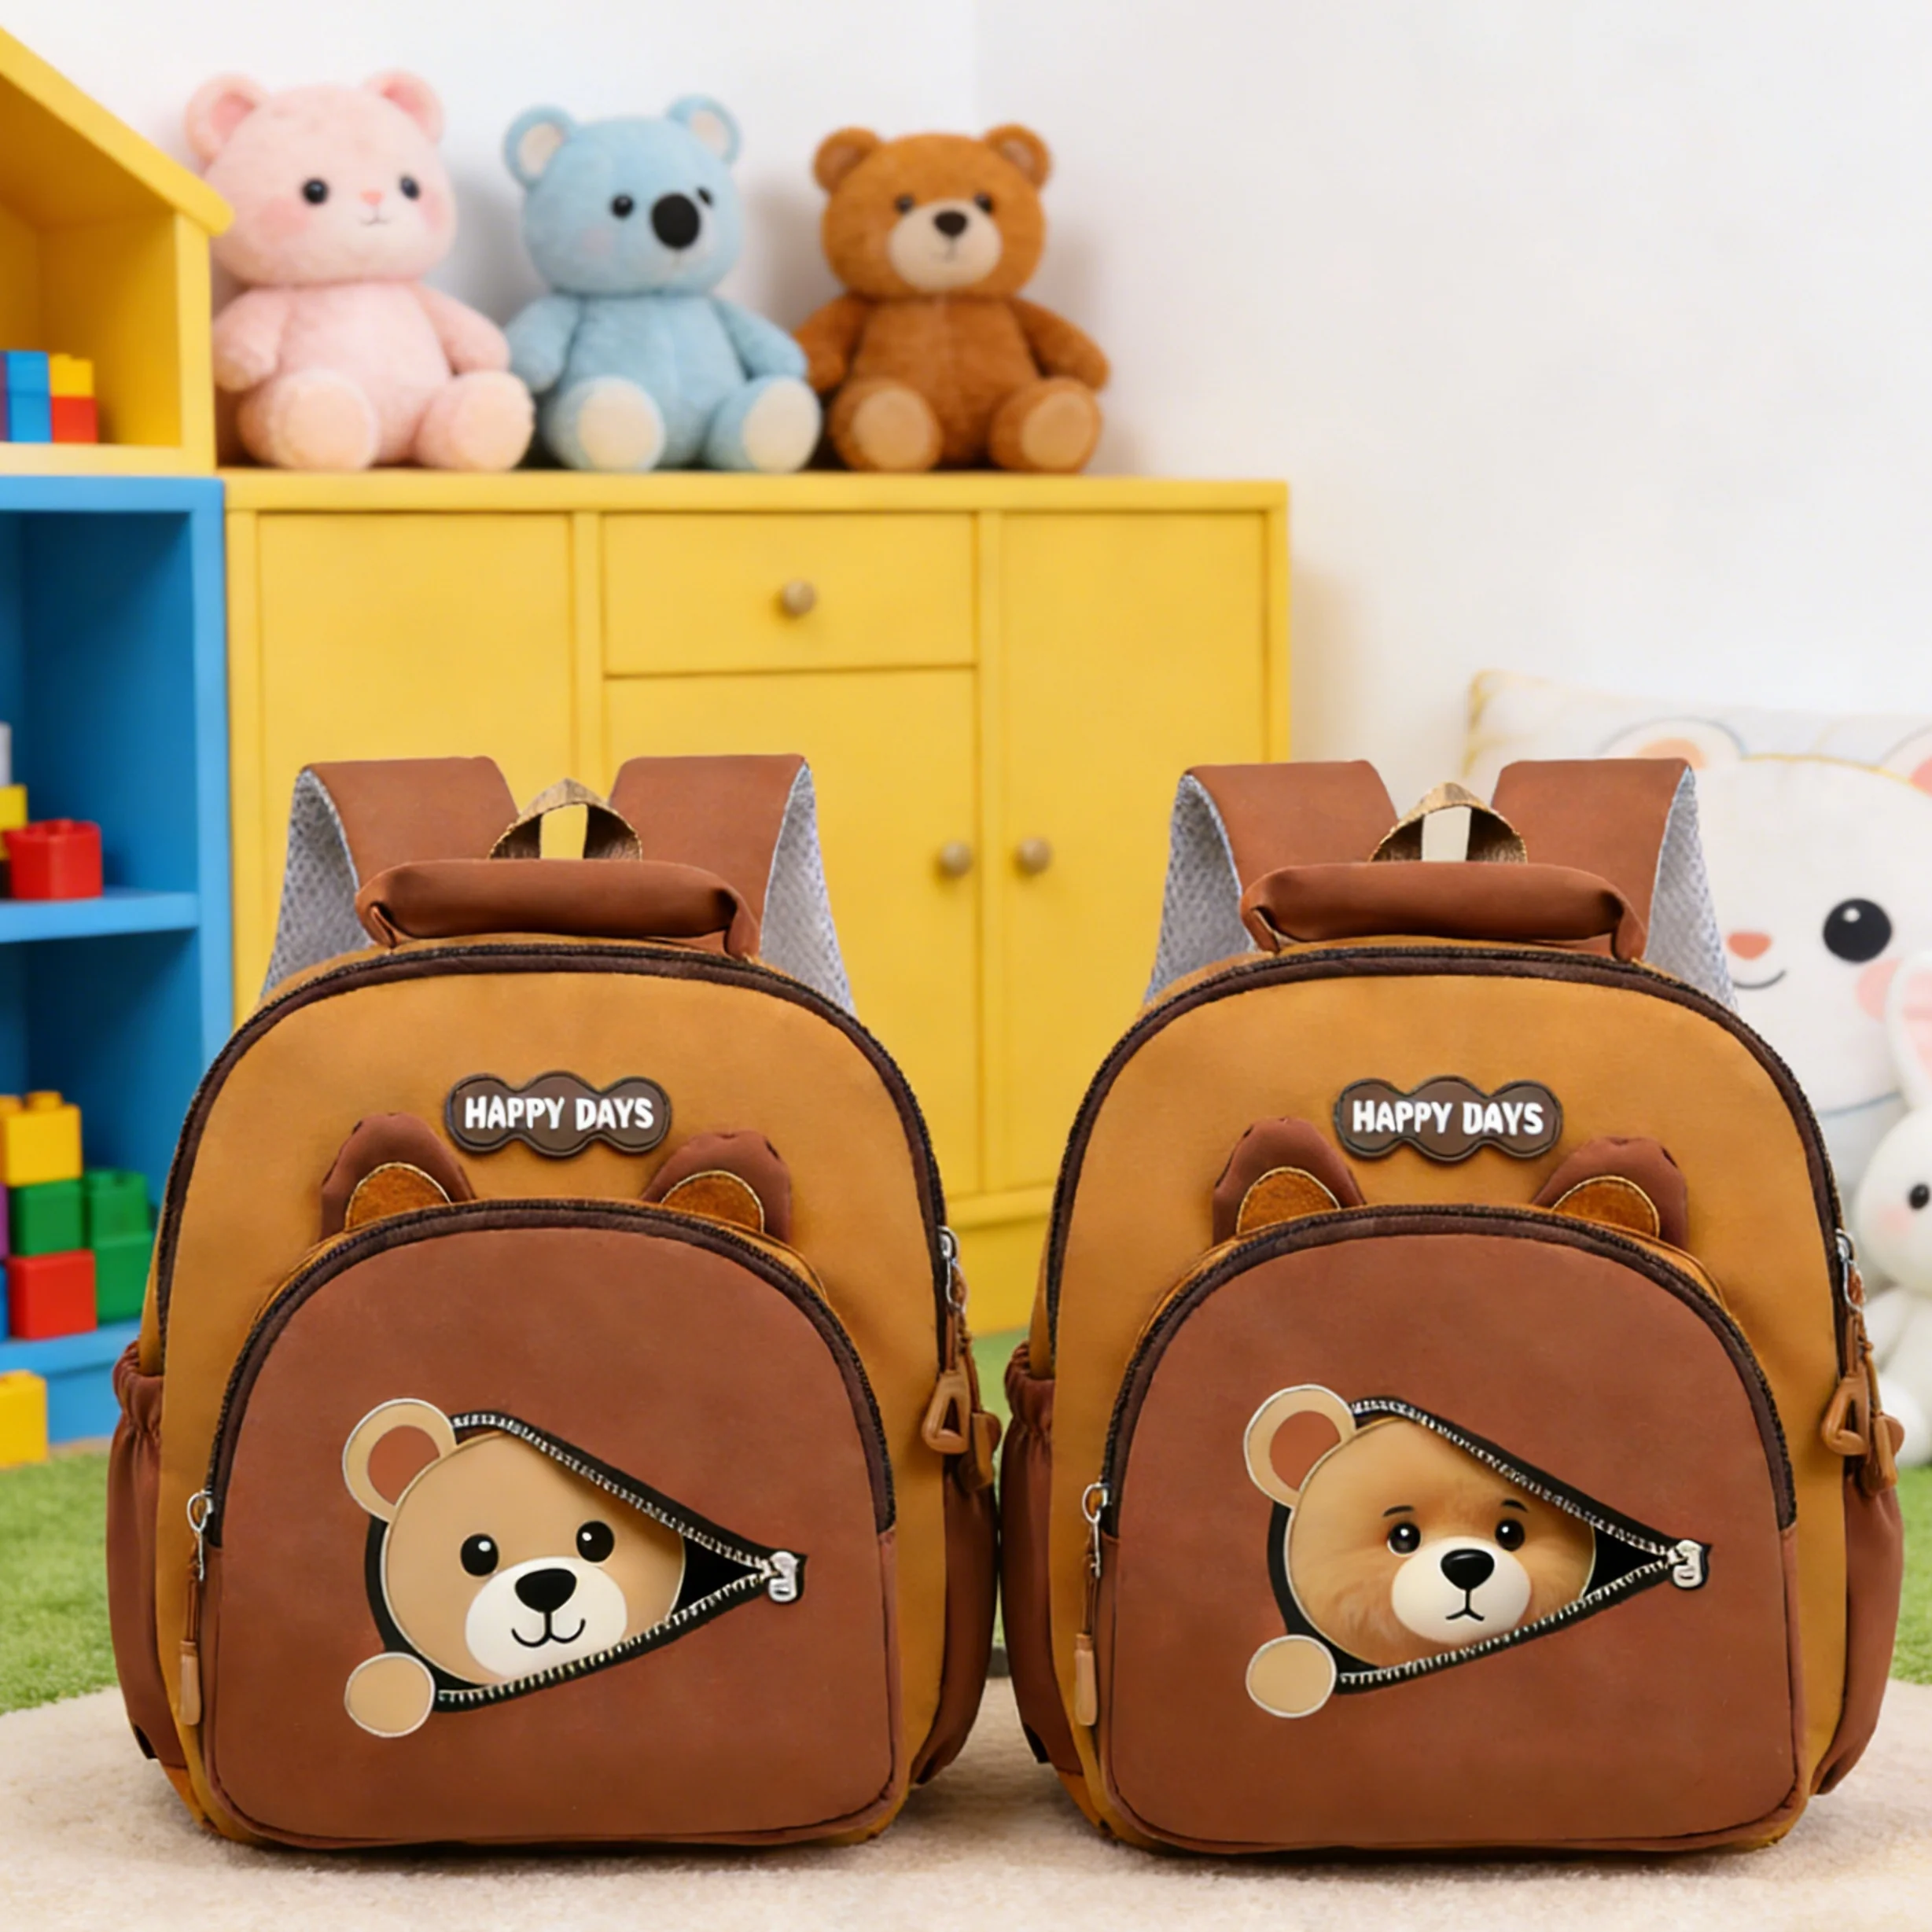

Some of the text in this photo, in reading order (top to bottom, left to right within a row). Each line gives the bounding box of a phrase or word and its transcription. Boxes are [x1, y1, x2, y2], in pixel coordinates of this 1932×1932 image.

[464, 1095, 655, 1132] HAPPY DAYS
[1352, 1099, 1545, 1135] HAPPY DAYS
